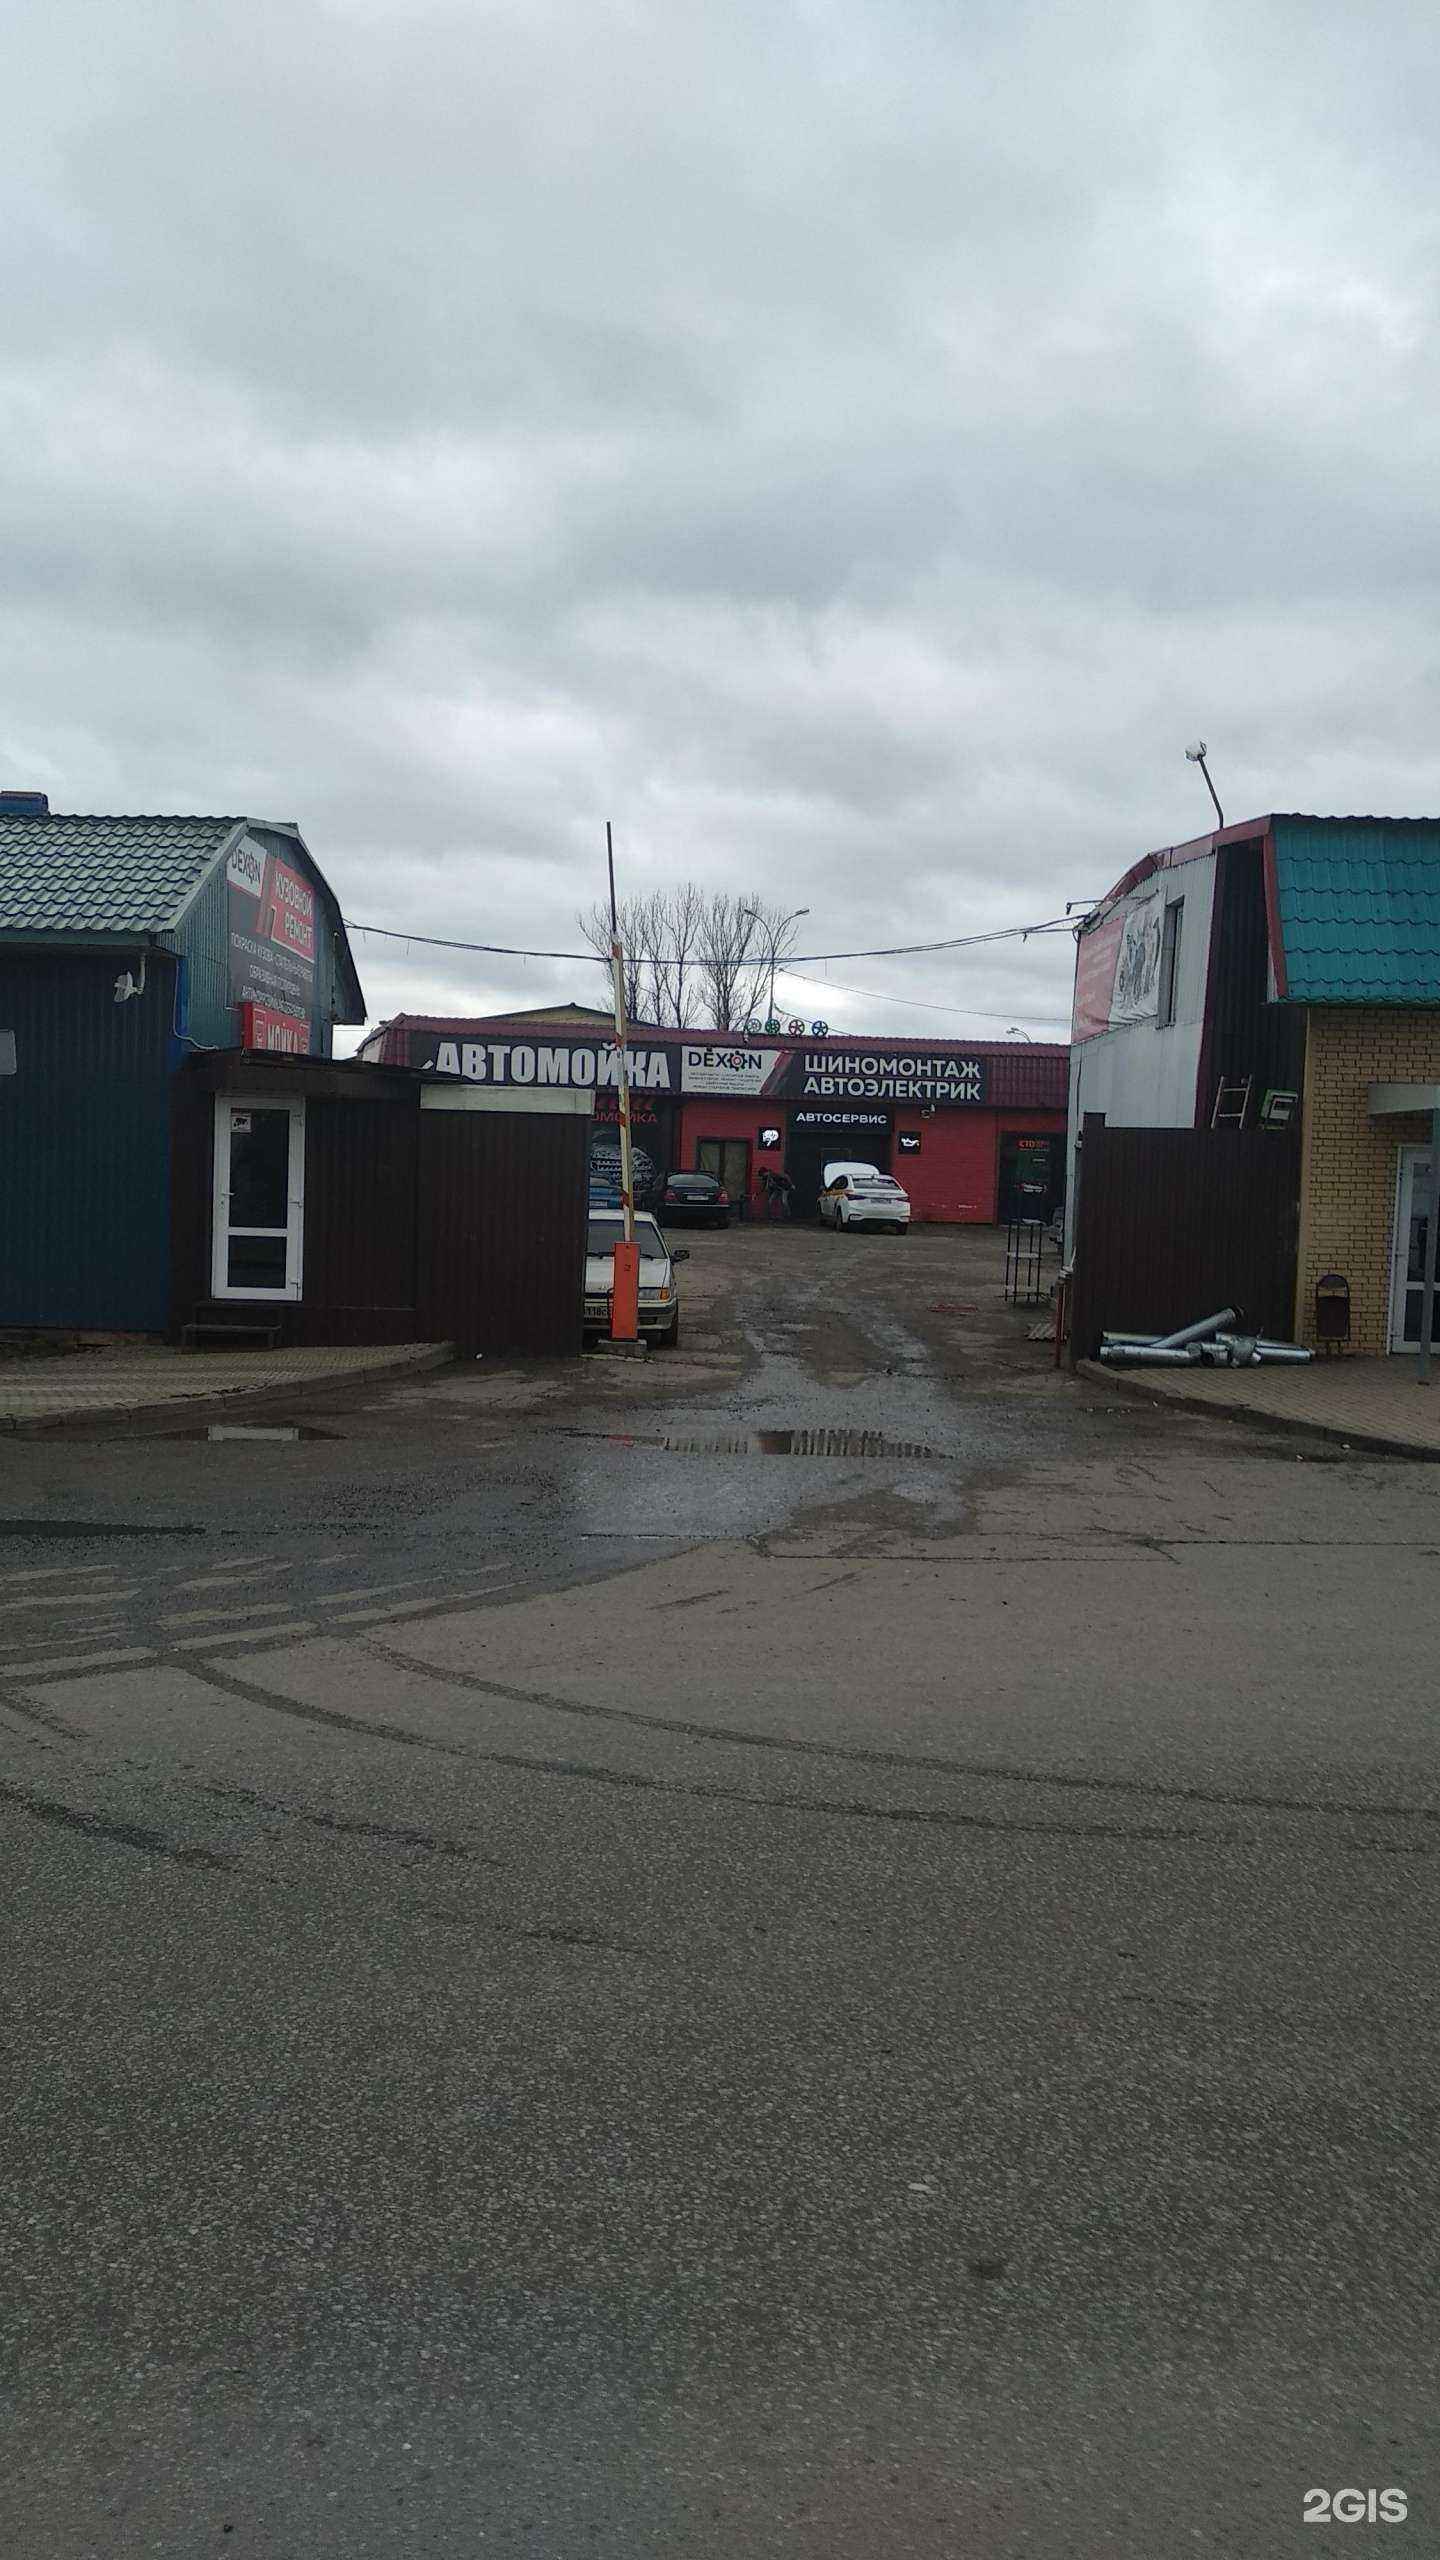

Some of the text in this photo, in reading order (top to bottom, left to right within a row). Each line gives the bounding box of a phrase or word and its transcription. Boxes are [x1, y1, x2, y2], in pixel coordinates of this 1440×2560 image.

[275, 871, 313, 918] КУЗОВНОЙ
[284, 912, 313, 949] РЕМОНТ
[436, 1042, 671, 1088] АВТОМОЙКА
[804, 1055, 981, 1079] ШИНОМОНТАЖ
[803, 1076, 981, 1101] АВТОЭЛЕКТРИК
[796, 1112, 888, 1126] АВТОСЕРВИС
